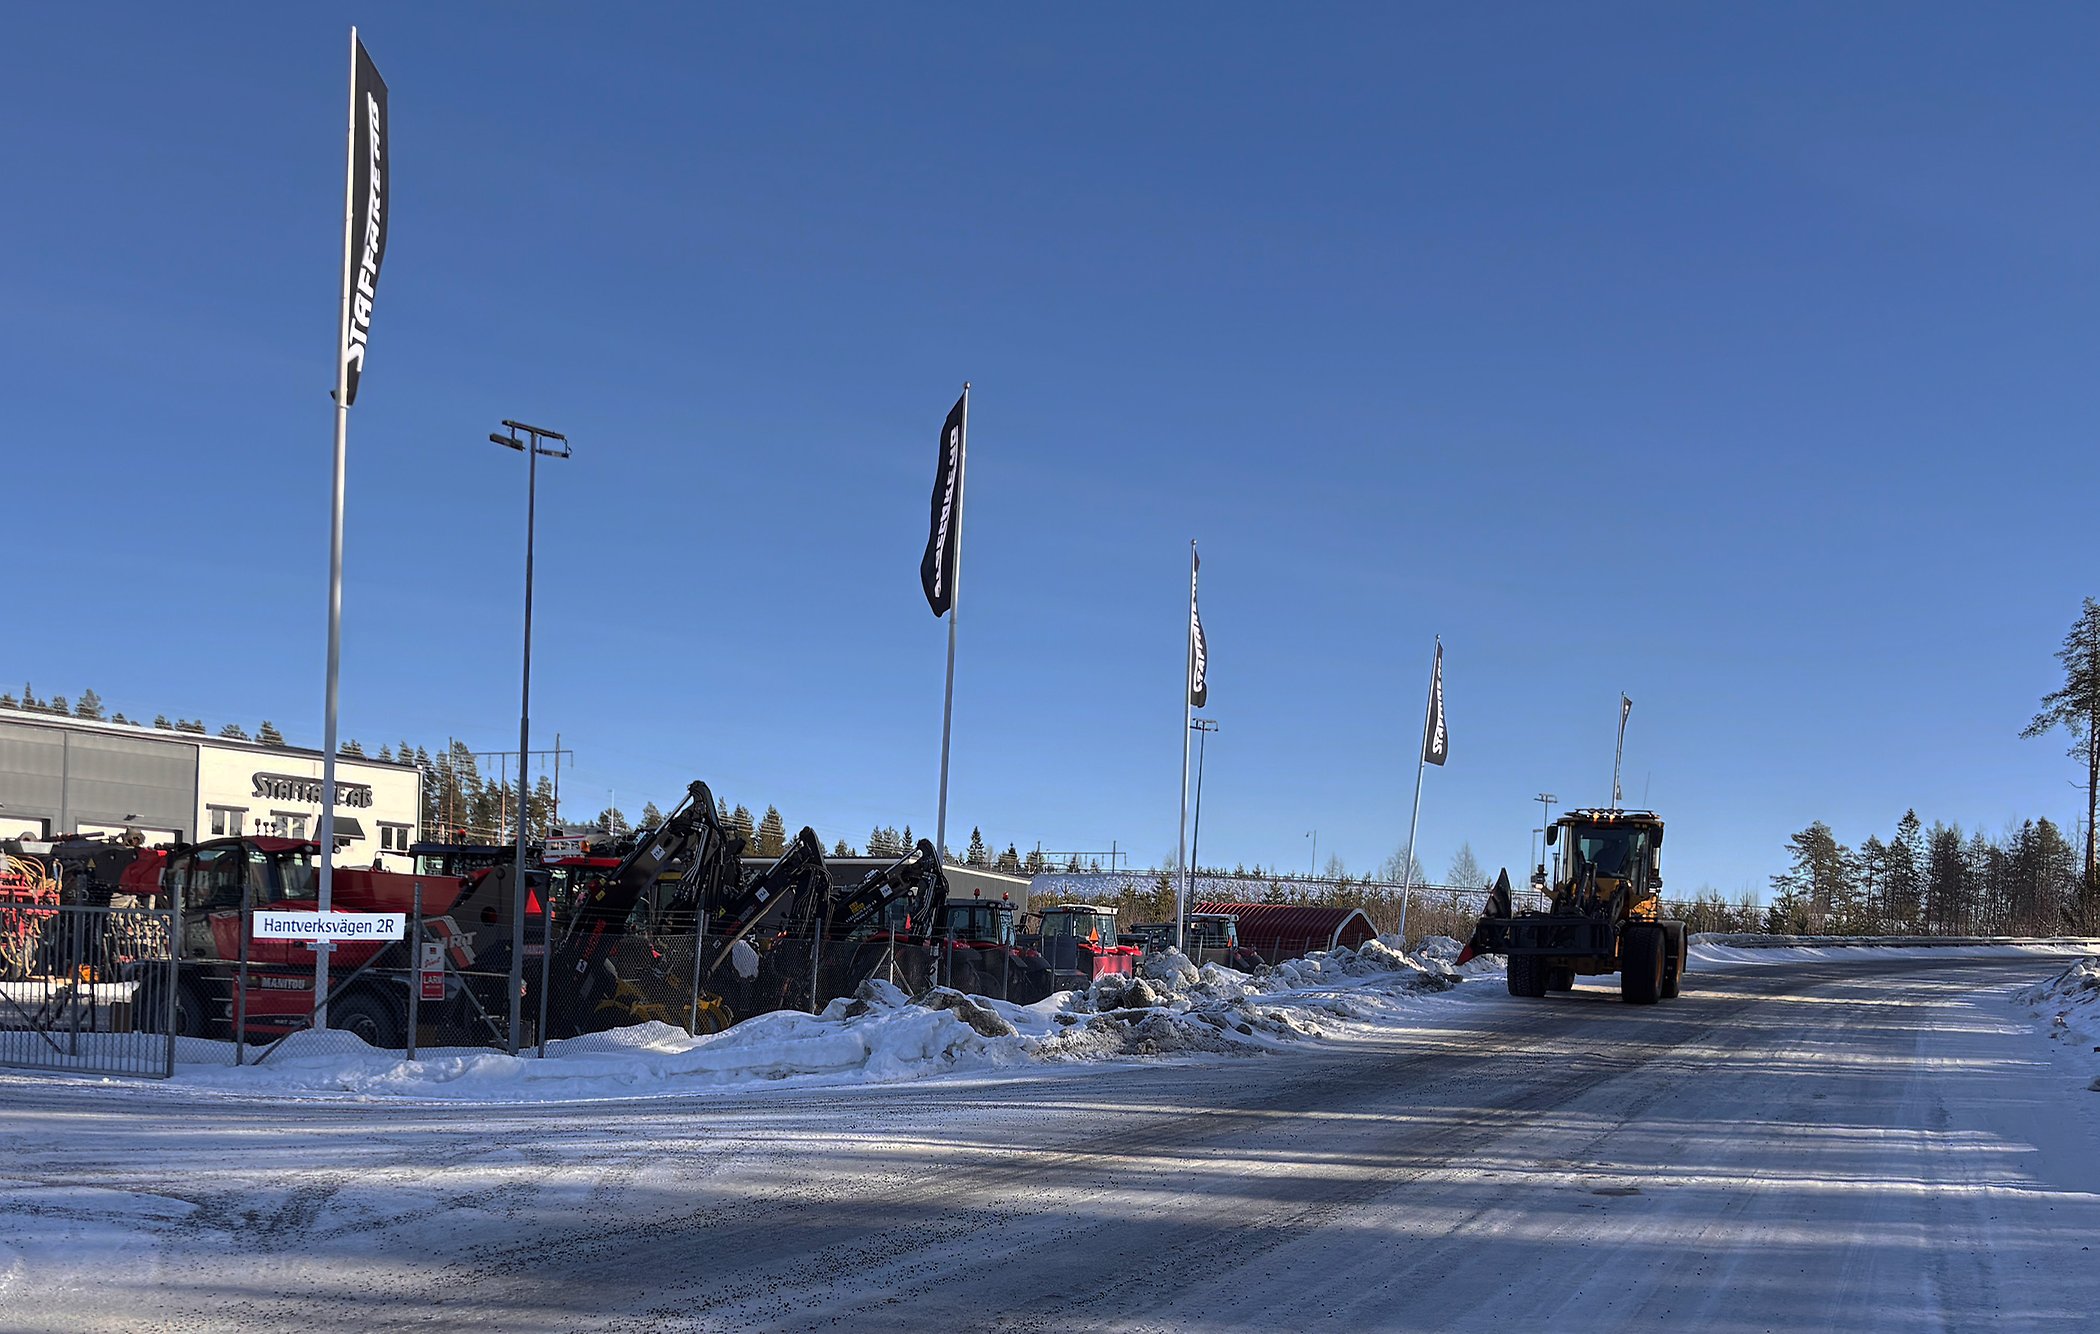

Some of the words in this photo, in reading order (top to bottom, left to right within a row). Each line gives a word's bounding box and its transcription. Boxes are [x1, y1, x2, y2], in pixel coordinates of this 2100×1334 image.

[347, 165, 381, 372] STAFFARE
[252, 772, 346, 805] STAFFAE
[264, 917, 372, 937] Hantverksvägen
[376, 918, 394, 933] 2R
[261, 977, 306, 990] MANITOU
